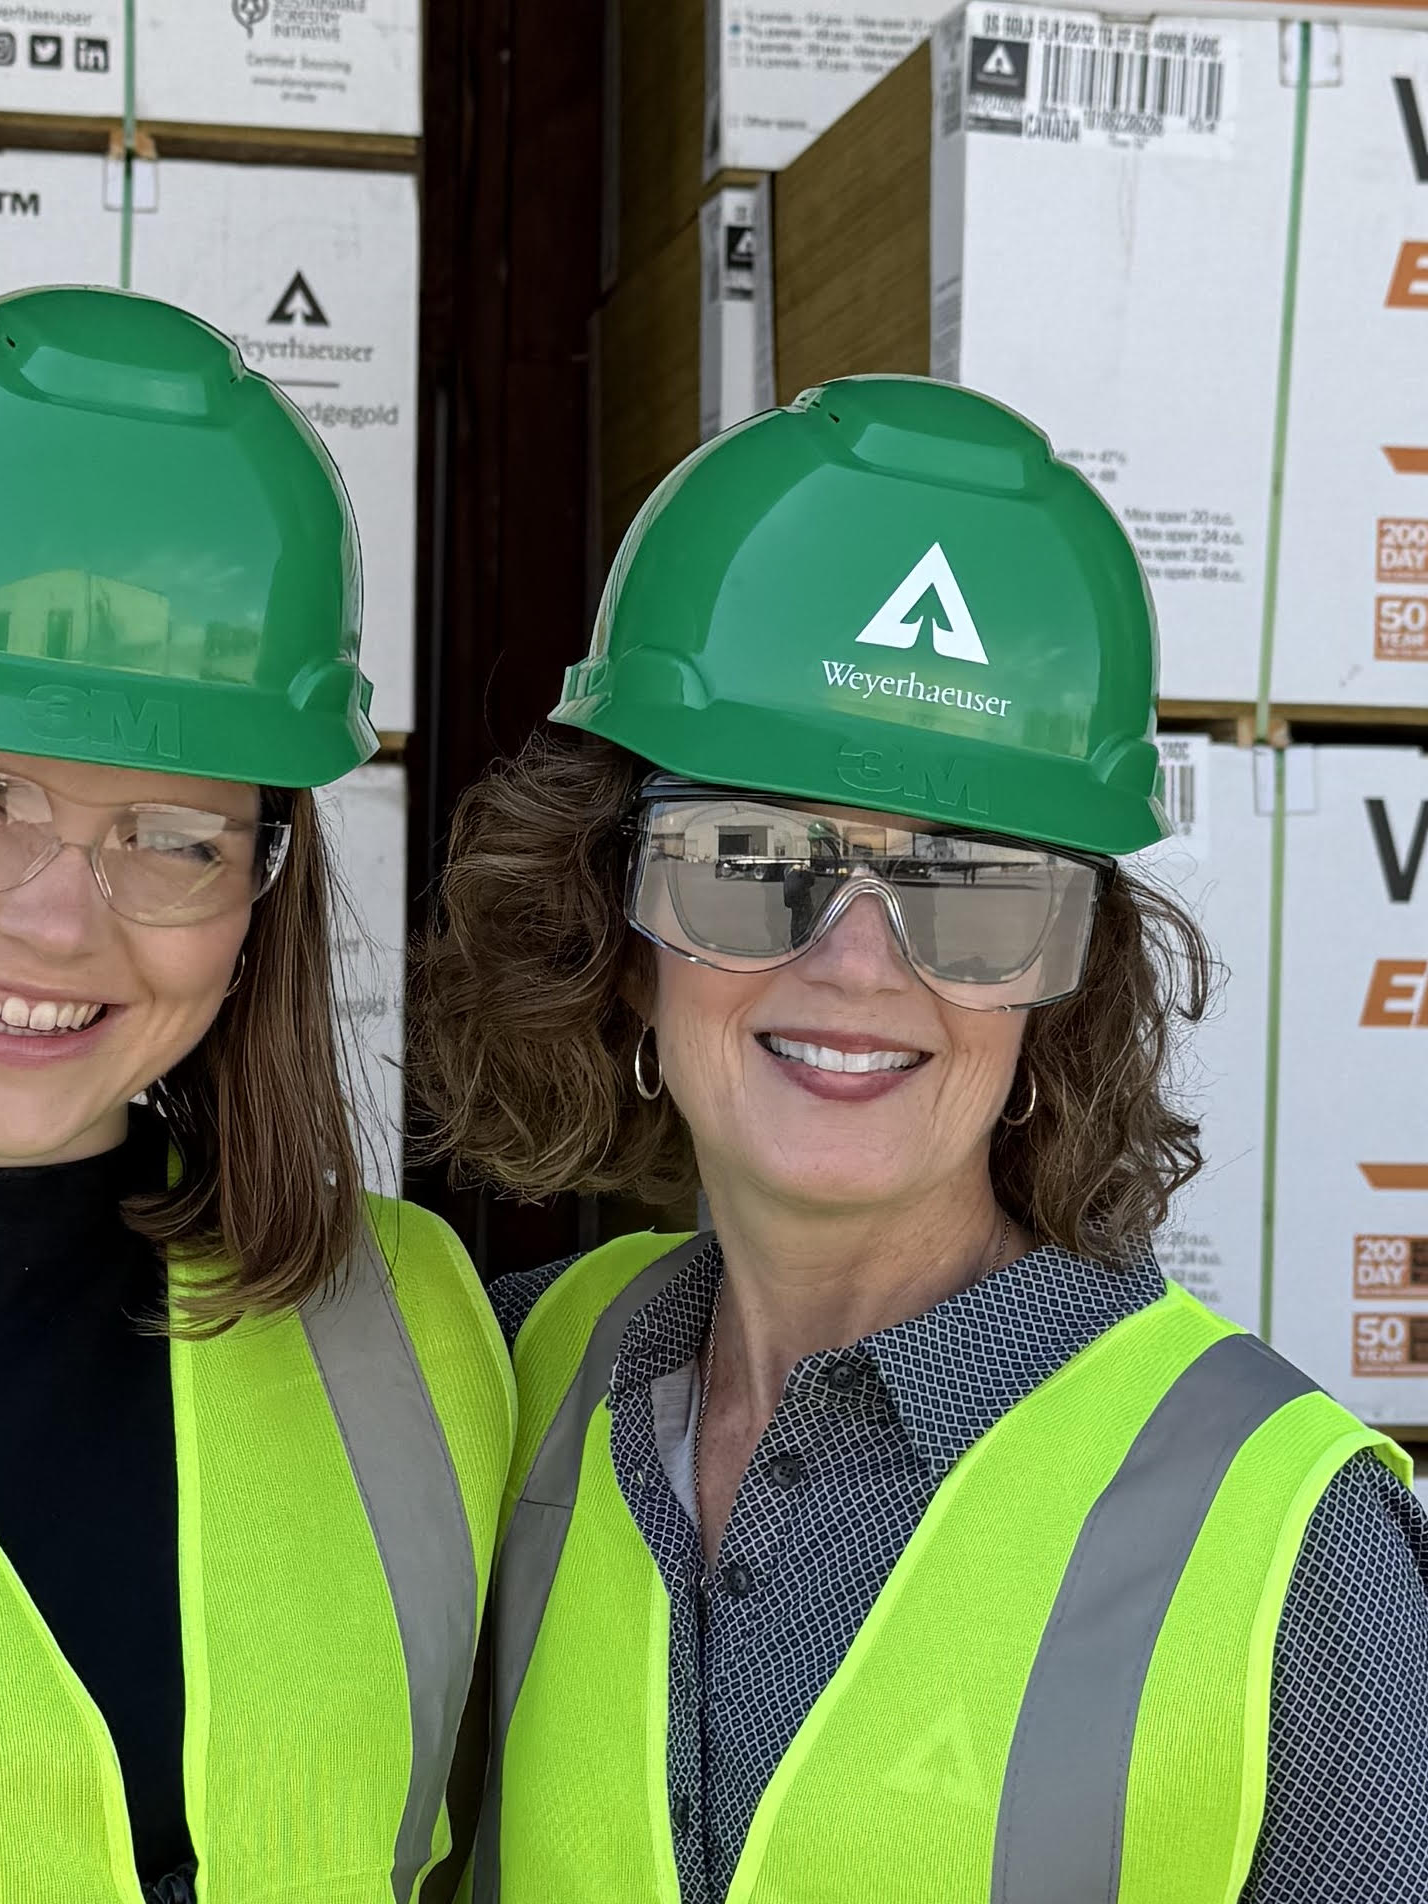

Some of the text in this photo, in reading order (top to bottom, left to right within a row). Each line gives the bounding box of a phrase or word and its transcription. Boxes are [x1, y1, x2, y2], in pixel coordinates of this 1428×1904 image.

[1380, 549, 1428, 570] DAY
[1379, 601, 1428, 631] 50
[822, 660, 1012, 717] Weyerhaeuser
[1358, 1238, 1407, 1262] 200
[1357, 1265, 1406, 1286] DAY
[1357, 1317, 1405, 1347] 50
